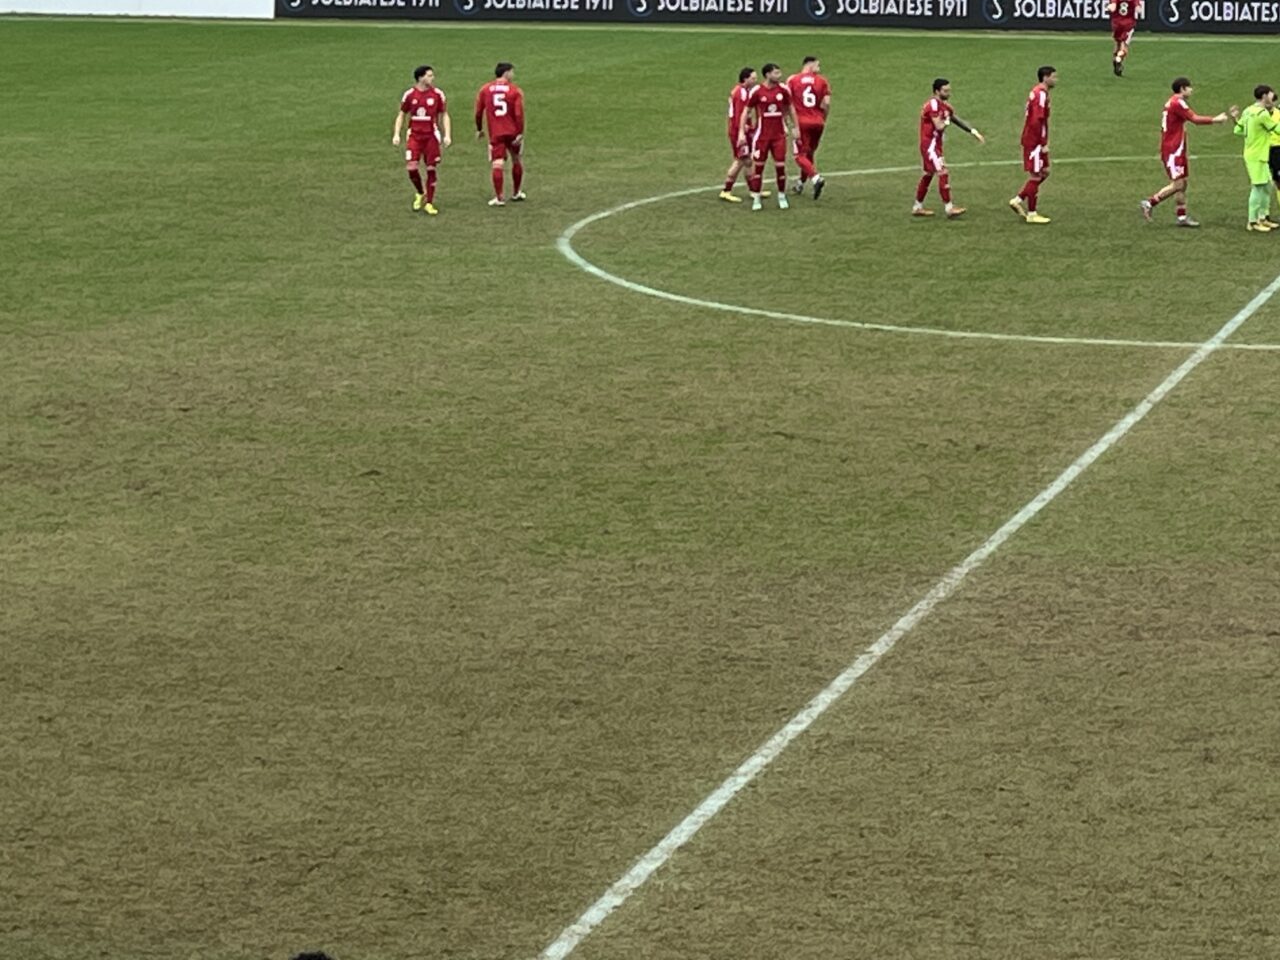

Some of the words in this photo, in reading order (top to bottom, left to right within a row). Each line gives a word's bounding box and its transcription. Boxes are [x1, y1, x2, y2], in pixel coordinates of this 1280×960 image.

[1119, 2, 1129, 16] 8
[493, 93, 508, 117] 5
[802, 85, 816, 108] 6
